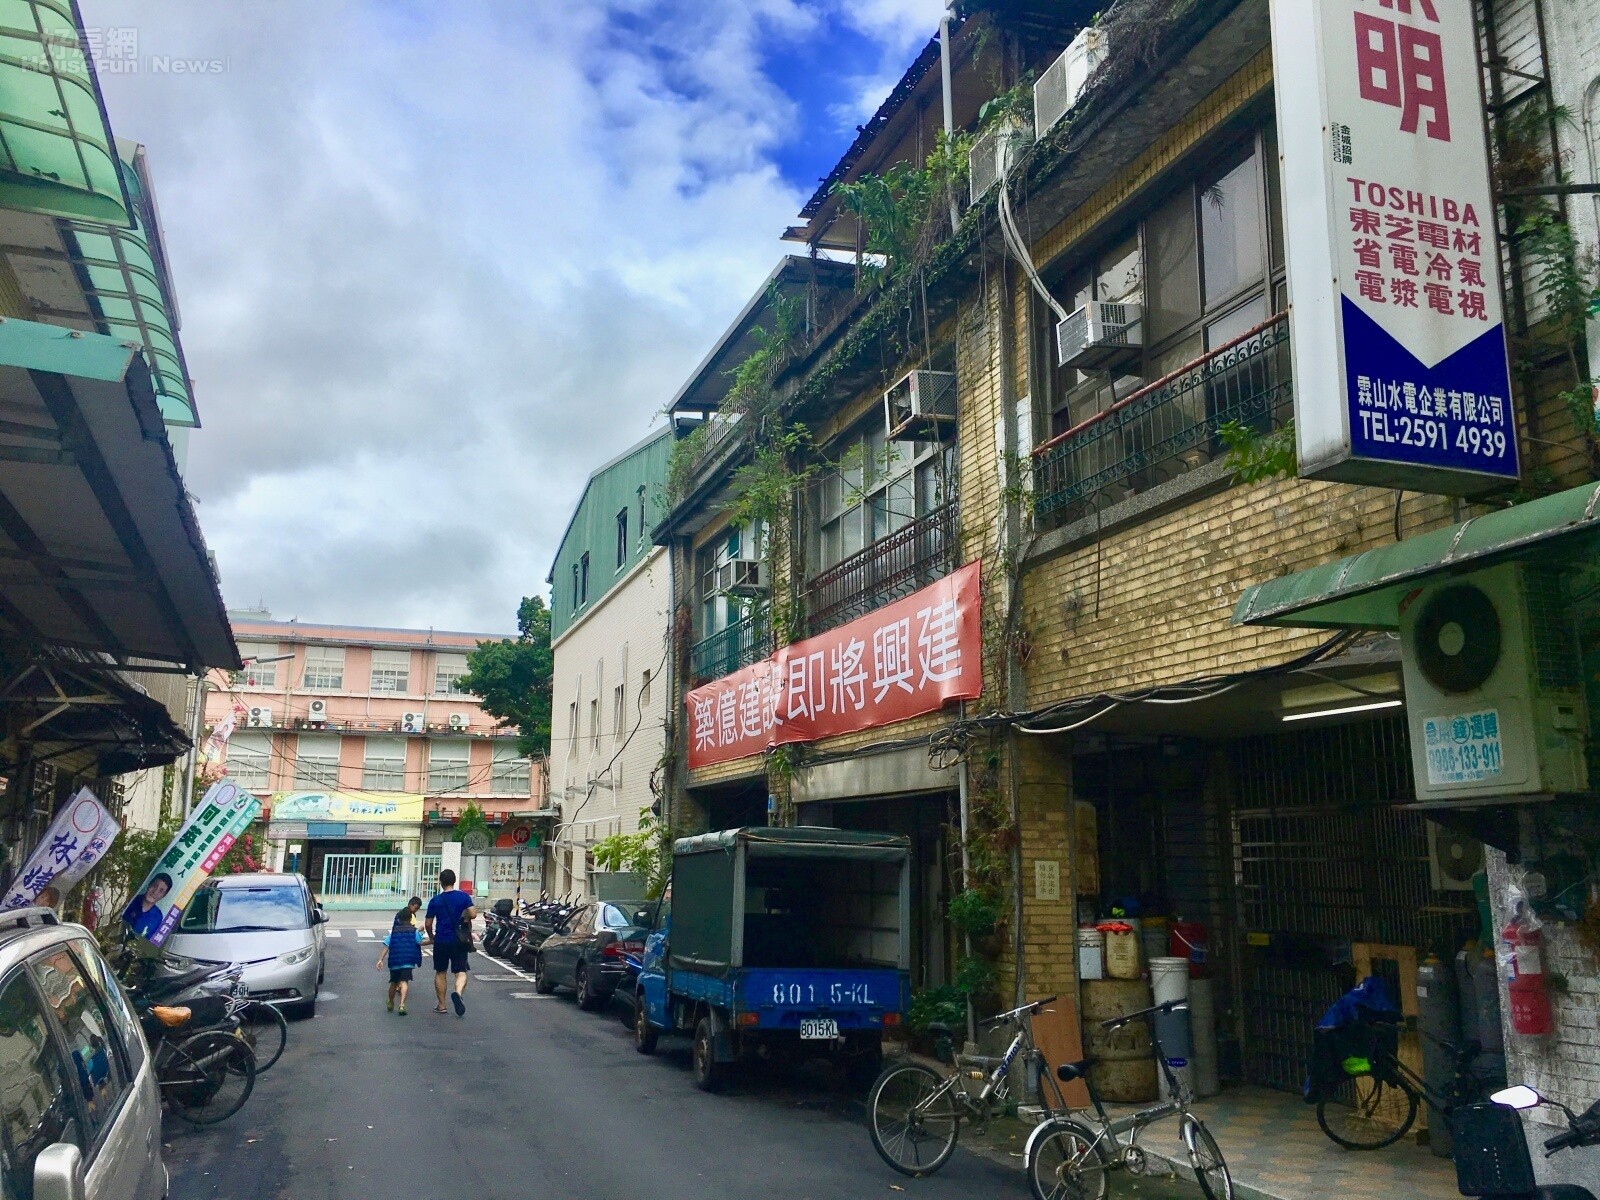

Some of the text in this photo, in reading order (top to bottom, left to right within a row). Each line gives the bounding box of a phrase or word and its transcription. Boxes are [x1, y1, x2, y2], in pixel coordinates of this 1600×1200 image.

[1353, 0, 1451, 142] 明
[1347, 177, 1480, 228] TOSHIBA
[1350, 206, 1482, 257] 東芝電材
[1353, 238, 1486, 288] 省電冷氣
[1355, 270, 1488, 321] 電漿電視
[1357, 375, 1505, 428] 霖山水電企業有限公司
[1359, 410, 1507, 459] TEL:2591 4939
